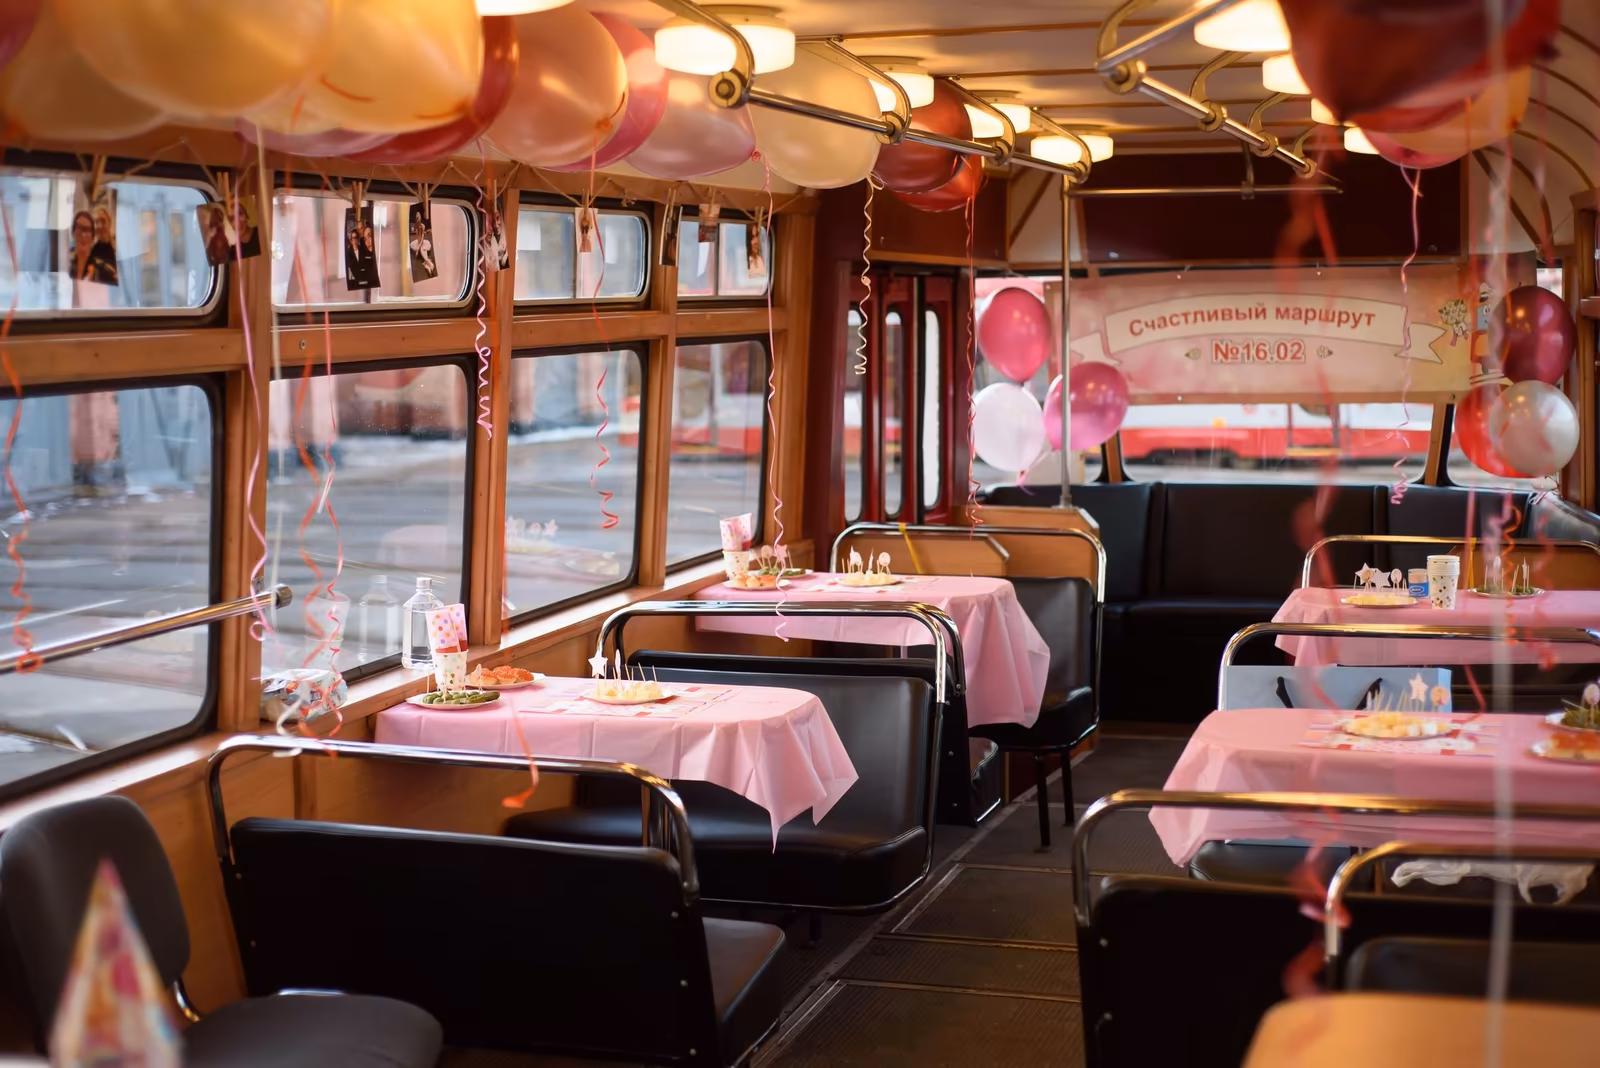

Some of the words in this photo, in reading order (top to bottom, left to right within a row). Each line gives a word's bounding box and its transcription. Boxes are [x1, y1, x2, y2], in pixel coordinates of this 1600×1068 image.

[1129, 303, 1267, 336] Счастливый
[1275, 306, 1376, 329] маршрут
[1213, 341, 1303, 361] №16.02
